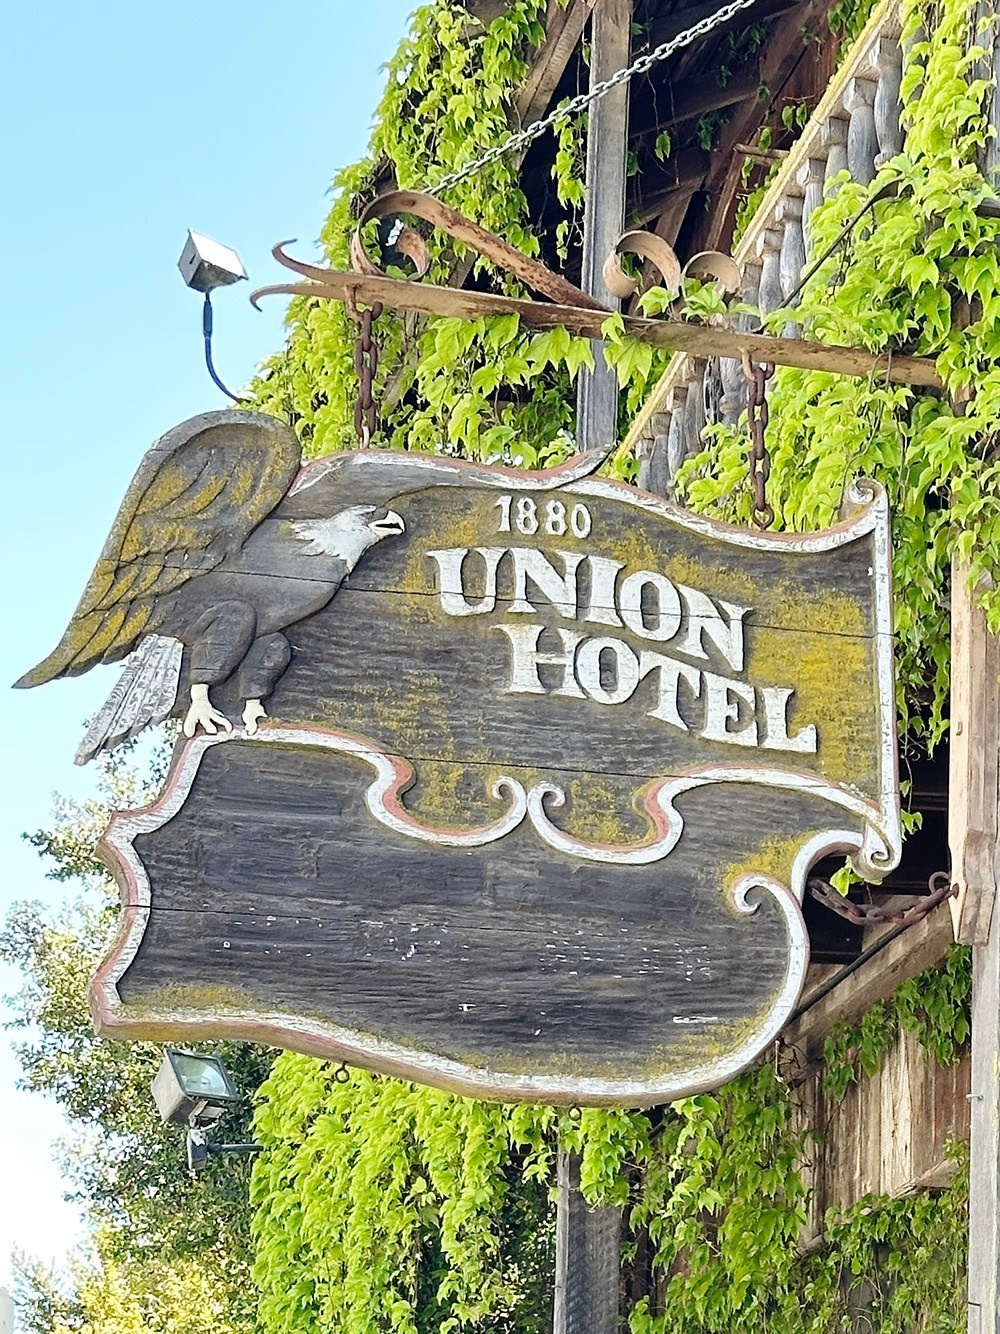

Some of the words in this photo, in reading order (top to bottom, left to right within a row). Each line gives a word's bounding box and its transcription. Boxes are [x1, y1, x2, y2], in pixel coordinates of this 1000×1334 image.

[496, 496, 591, 539] 1880
[427, 548, 752, 673] UNION
[491, 624, 818, 753] HOTEL
